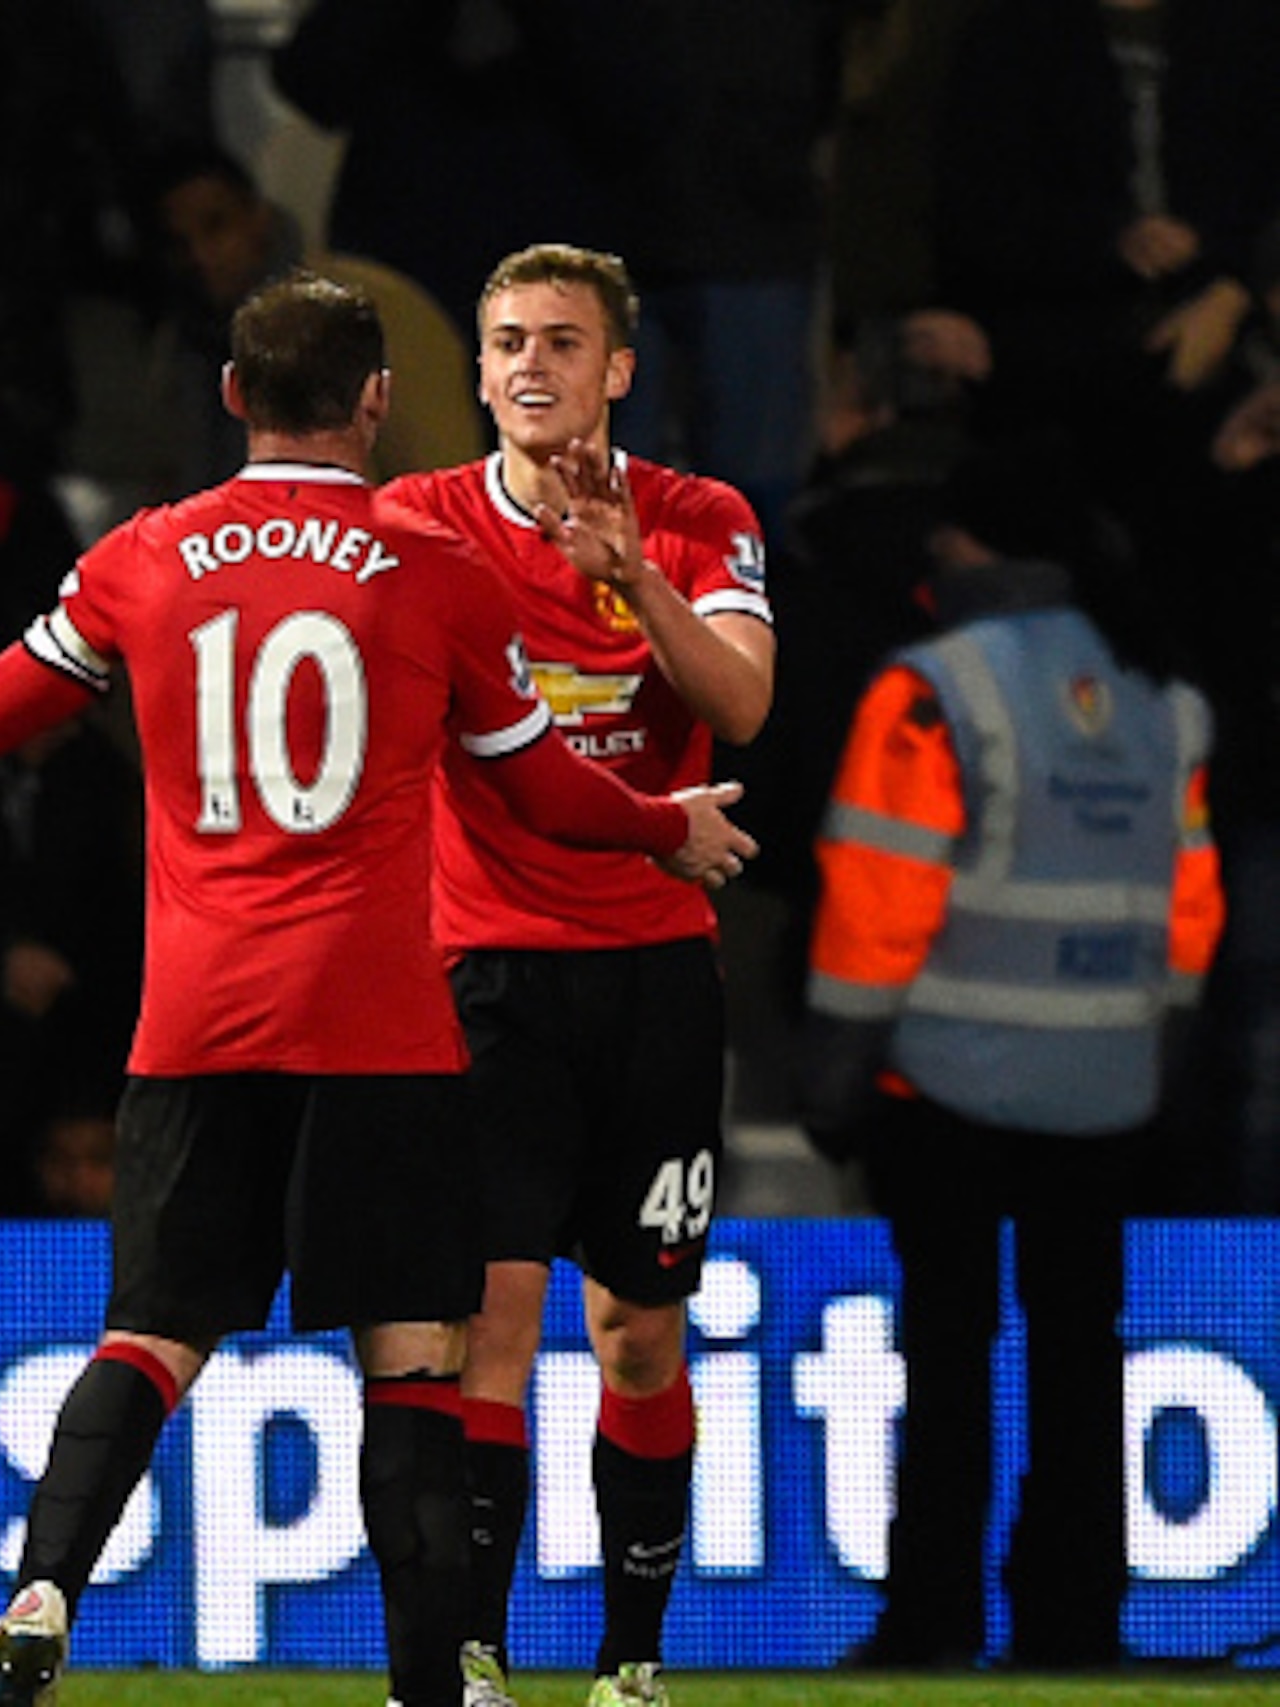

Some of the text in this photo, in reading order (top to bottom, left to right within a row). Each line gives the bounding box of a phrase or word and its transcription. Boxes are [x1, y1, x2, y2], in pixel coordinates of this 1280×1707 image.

[179, 517, 400, 584] ROONEY
[187, 605, 368, 834] 10
[637, 1148, 714, 1245] 49
